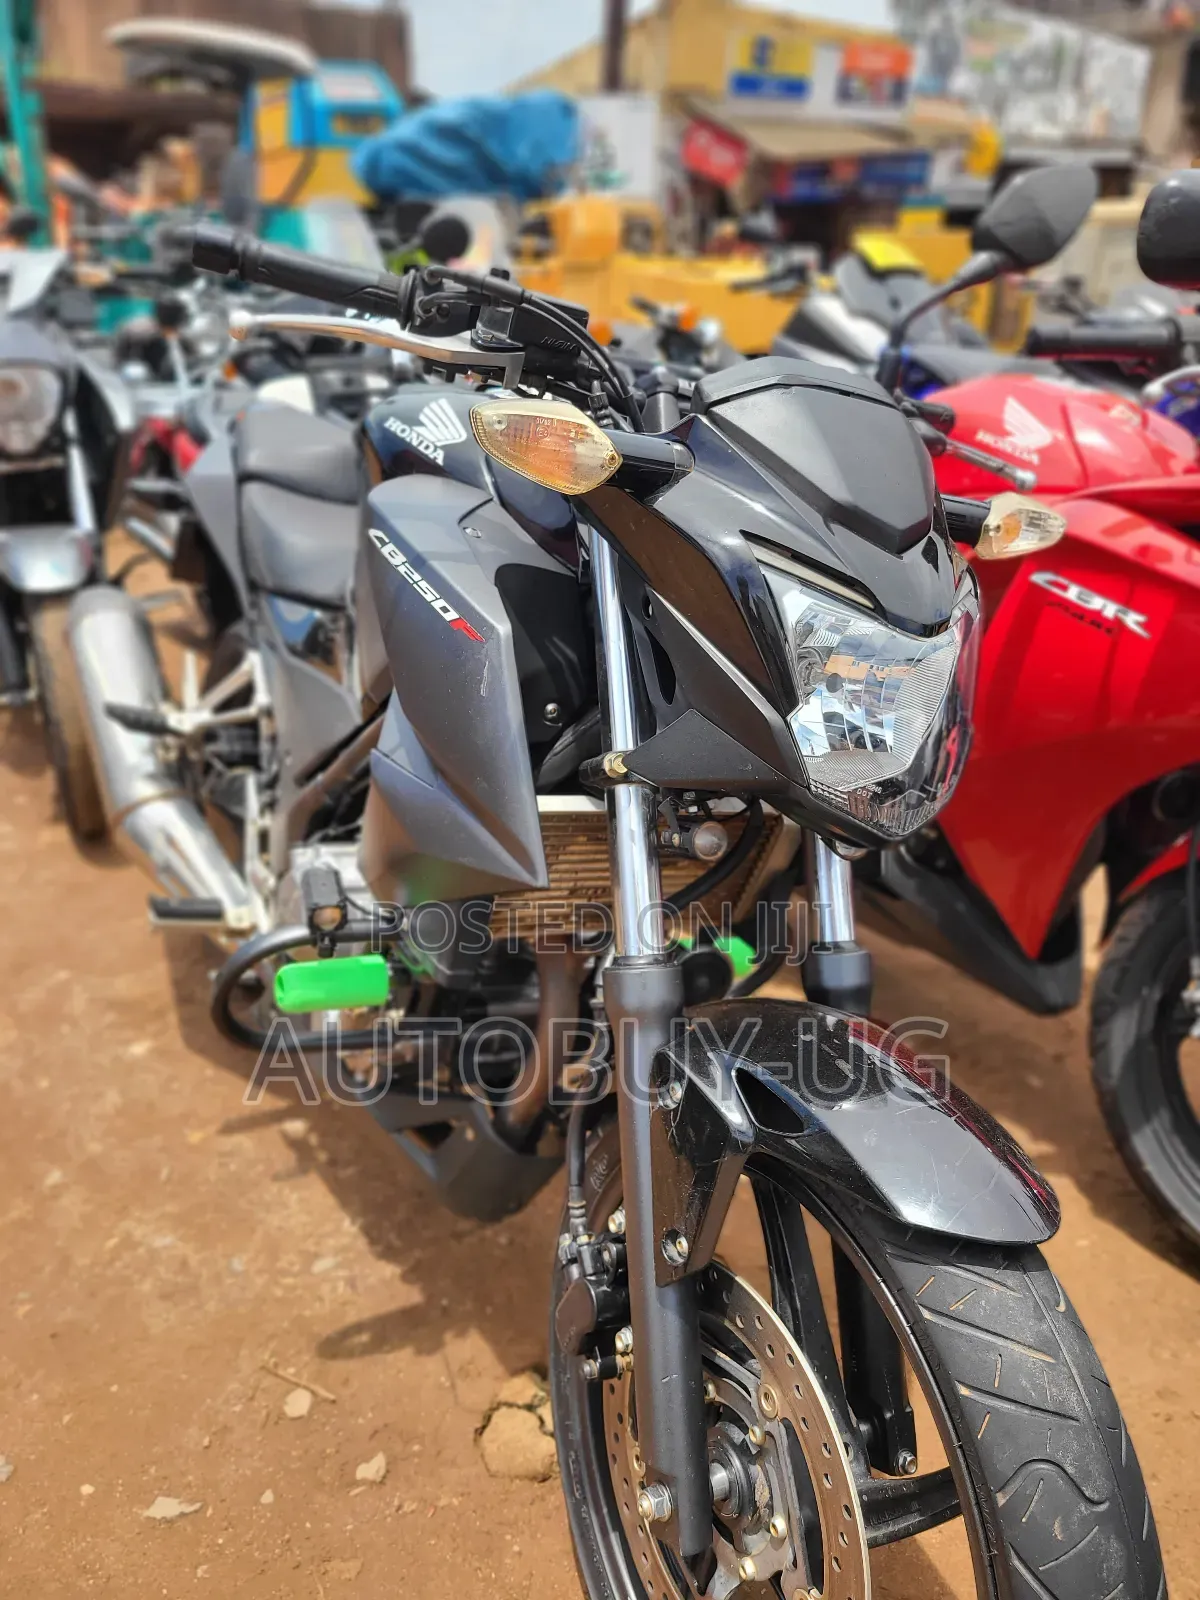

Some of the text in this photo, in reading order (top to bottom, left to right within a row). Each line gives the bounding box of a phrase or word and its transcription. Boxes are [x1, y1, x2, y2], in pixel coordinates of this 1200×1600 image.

[383, 416, 445, 467] HONDA
[368, 528, 486, 643] CB250F
[1028, 571, 1152, 640] CBR
[856, 787, 873, 799] DOT
